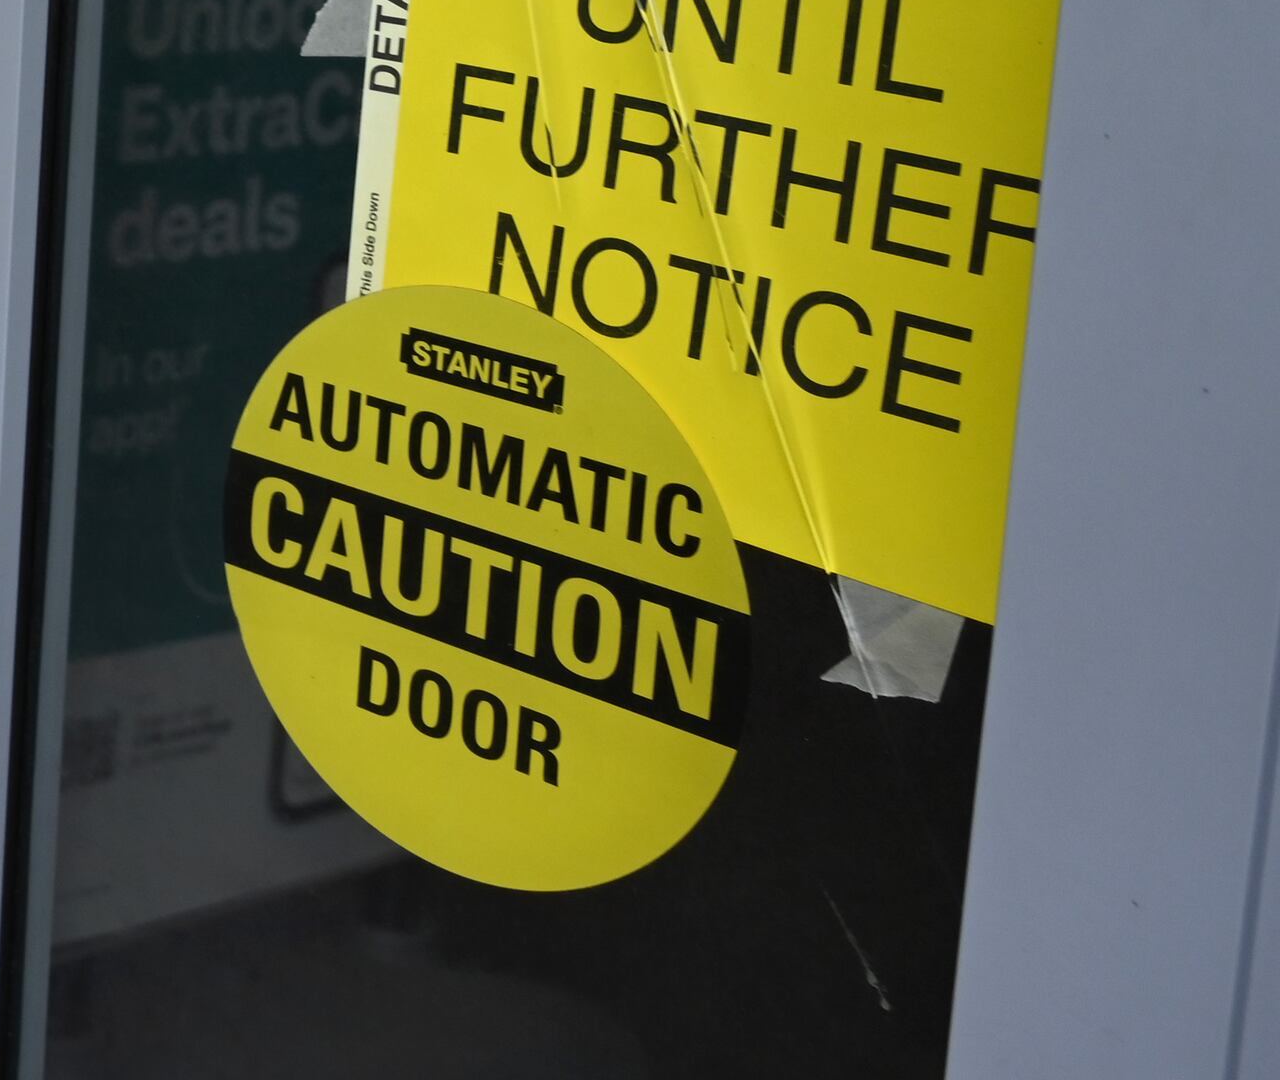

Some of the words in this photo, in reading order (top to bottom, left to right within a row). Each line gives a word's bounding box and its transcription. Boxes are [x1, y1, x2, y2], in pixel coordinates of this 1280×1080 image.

[116, 69, 362, 163] ExtraC
[108, 173, 303, 269] deals
[362, 235, 376, 266] Side
[365, 192, 380, 231] Down
[412, 340, 553, 399] STANLEY
[488, 210, 974, 434] NOTICE
[269, 371, 703, 559] AUTOMATIC
[250, 476, 718, 721] CAUTION
[356, 645, 562, 788] DOOR
